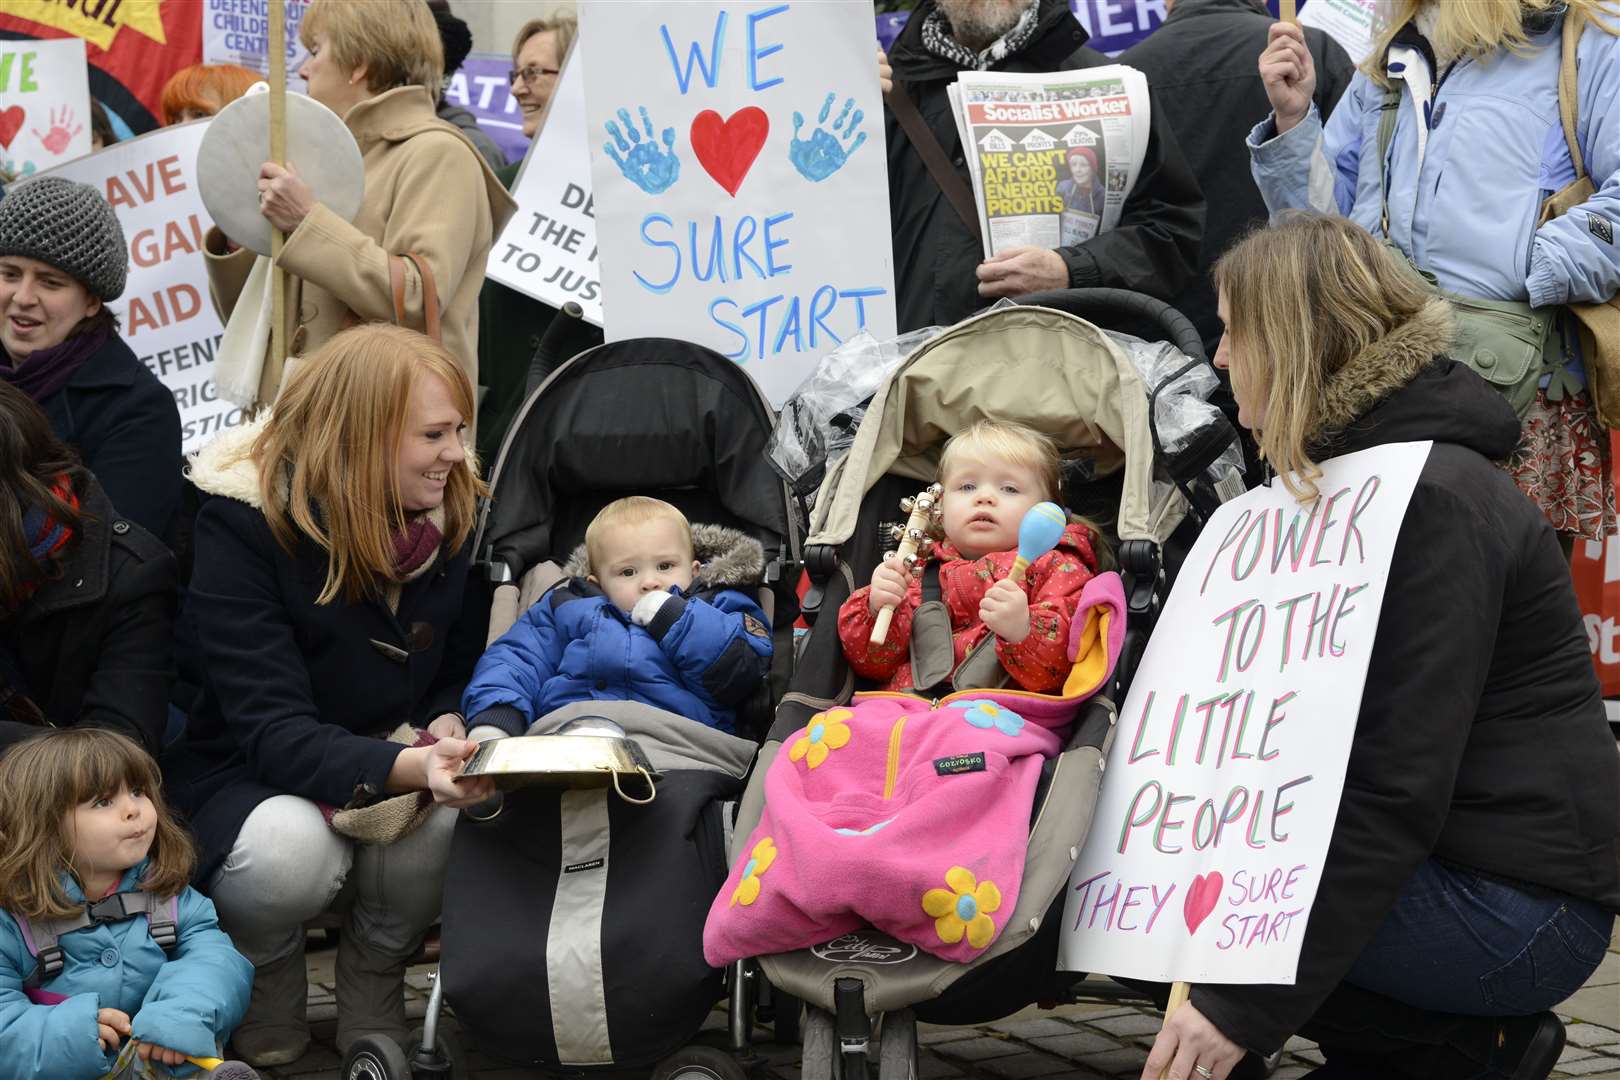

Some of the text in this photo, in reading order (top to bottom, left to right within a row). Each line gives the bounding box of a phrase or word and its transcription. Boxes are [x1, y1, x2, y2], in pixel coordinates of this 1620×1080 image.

[660, 4, 790, 95] WE
[983, 98, 1129, 121] Socialist Worker
[981, 149, 1067, 168] WE CAN'T
[984, 166, 1057, 184] AFFORD
[985, 180, 1058, 200] ENERGY
[528, 211, 586, 254] THE
[987, 196, 1065, 217] PROFITS
[501, 243, 602, 306] TO JUS
[633, 212, 794, 295] SURE
[128, 283, 202, 336] AID
[708, 285, 887, 364] START
[1200, 475, 1381, 596] POWER
[1212, 583, 1369, 683] TO THE
[1128, 689, 1300, 769] LITTLE
[1117, 775, 1314, 855] PEOPLE
[1074, 864, 1307, 934] THEY SURE
[1216, 908, 1304, 950] START
